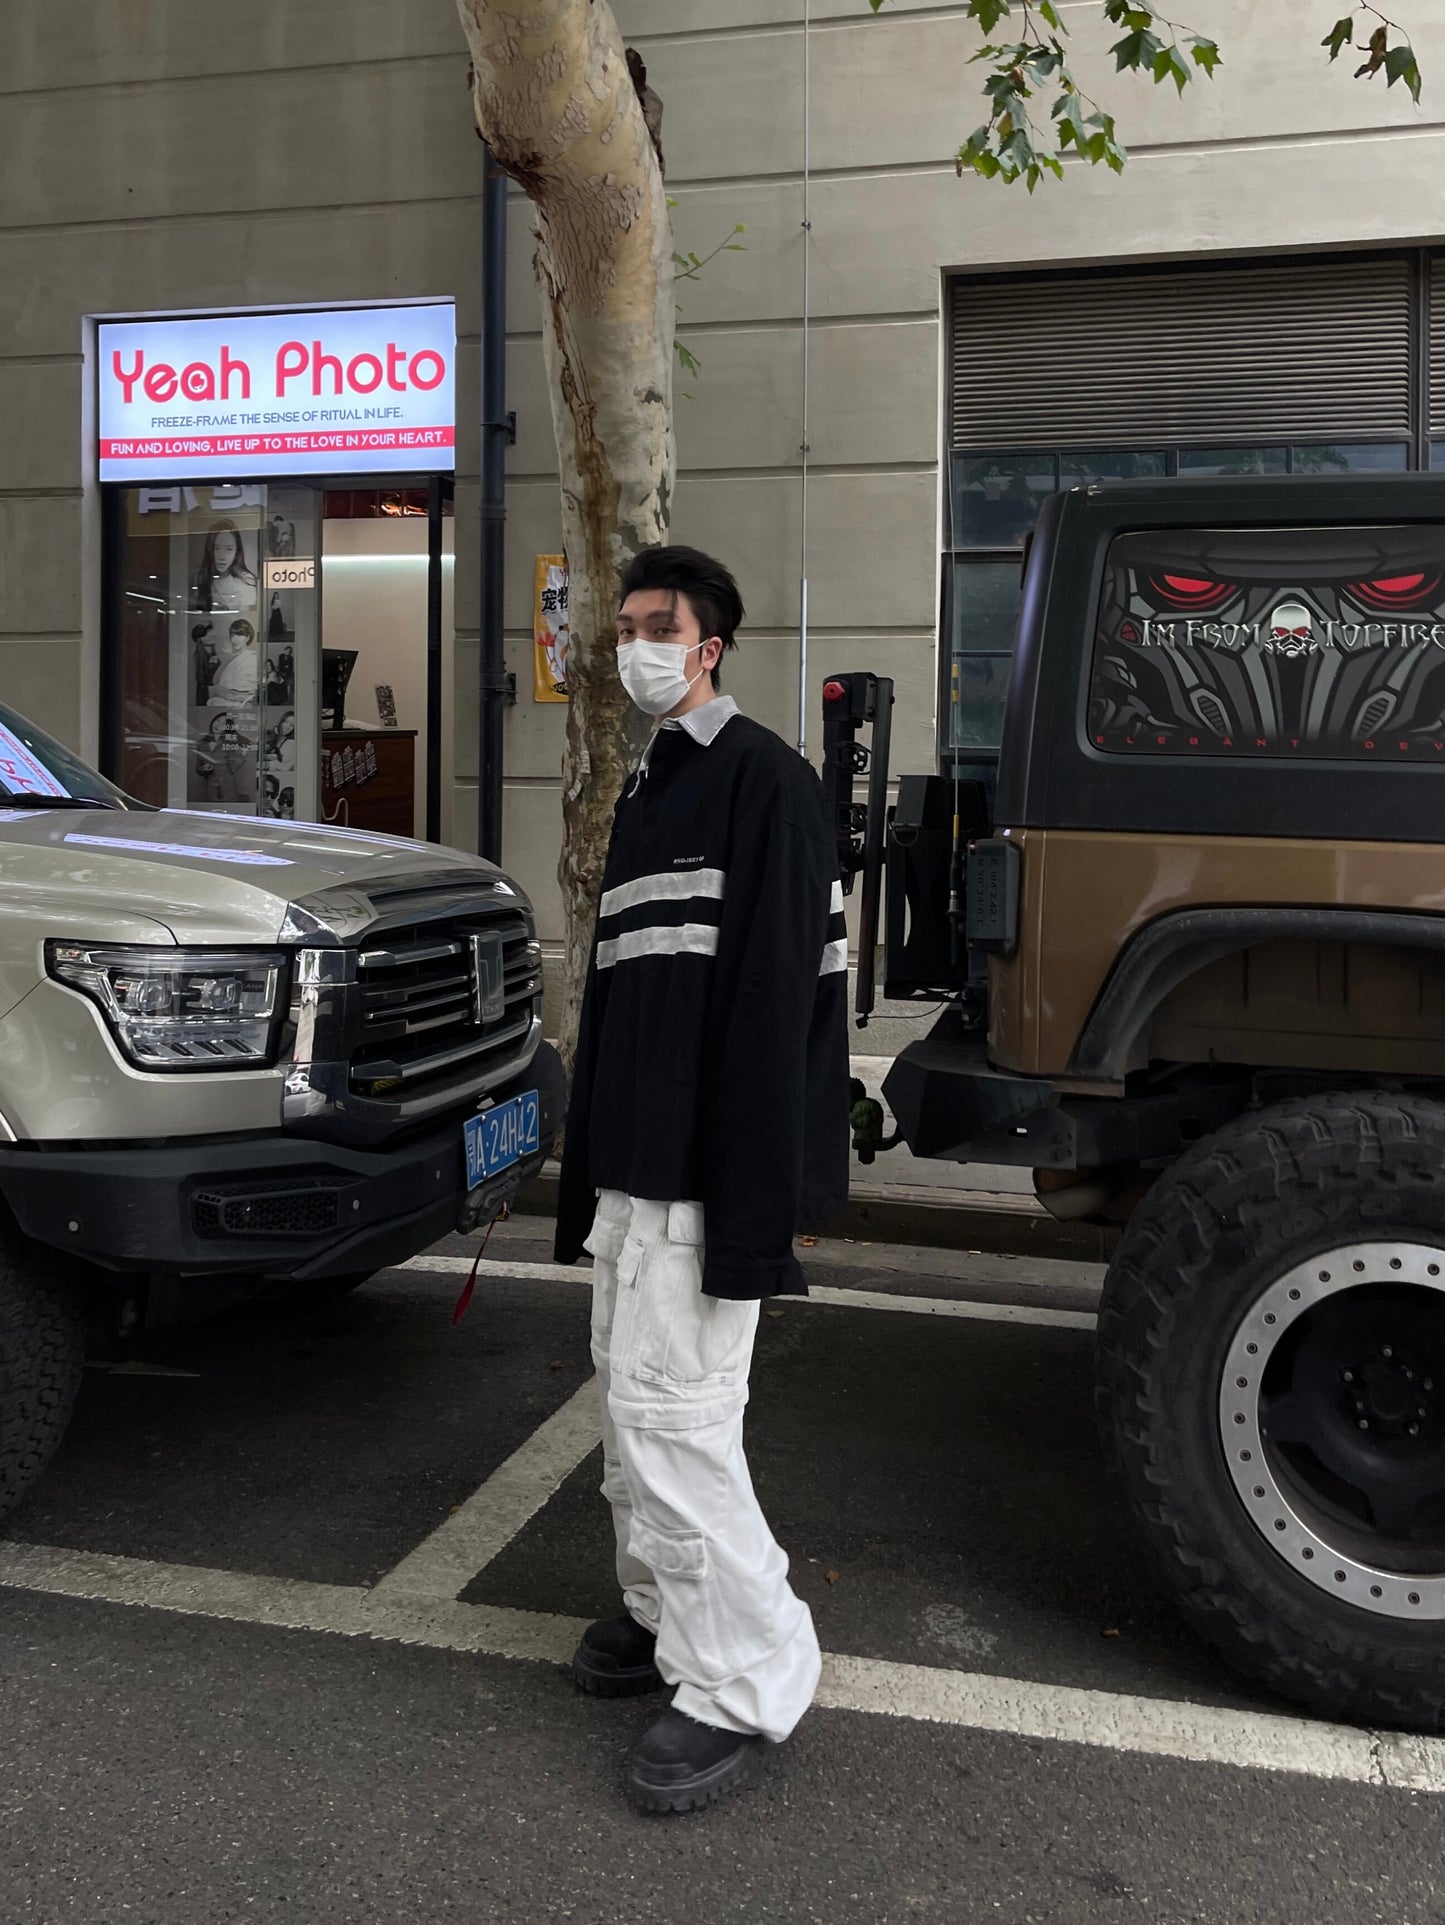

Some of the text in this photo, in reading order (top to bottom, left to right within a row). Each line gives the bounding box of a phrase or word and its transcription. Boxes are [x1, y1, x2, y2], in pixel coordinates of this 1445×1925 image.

[112, 340, 446, 404] Yeah Photo
[151, 407, 403, 428] FREEZE-FRAME THE SENSE OF RITUAL IN LIFE.
[111, 431, 447, 455] FUN AND LOVING, LIVE UP TO THE LOVE IN YOUR HEART.
[1185, 620, 1260, 648] FROM
